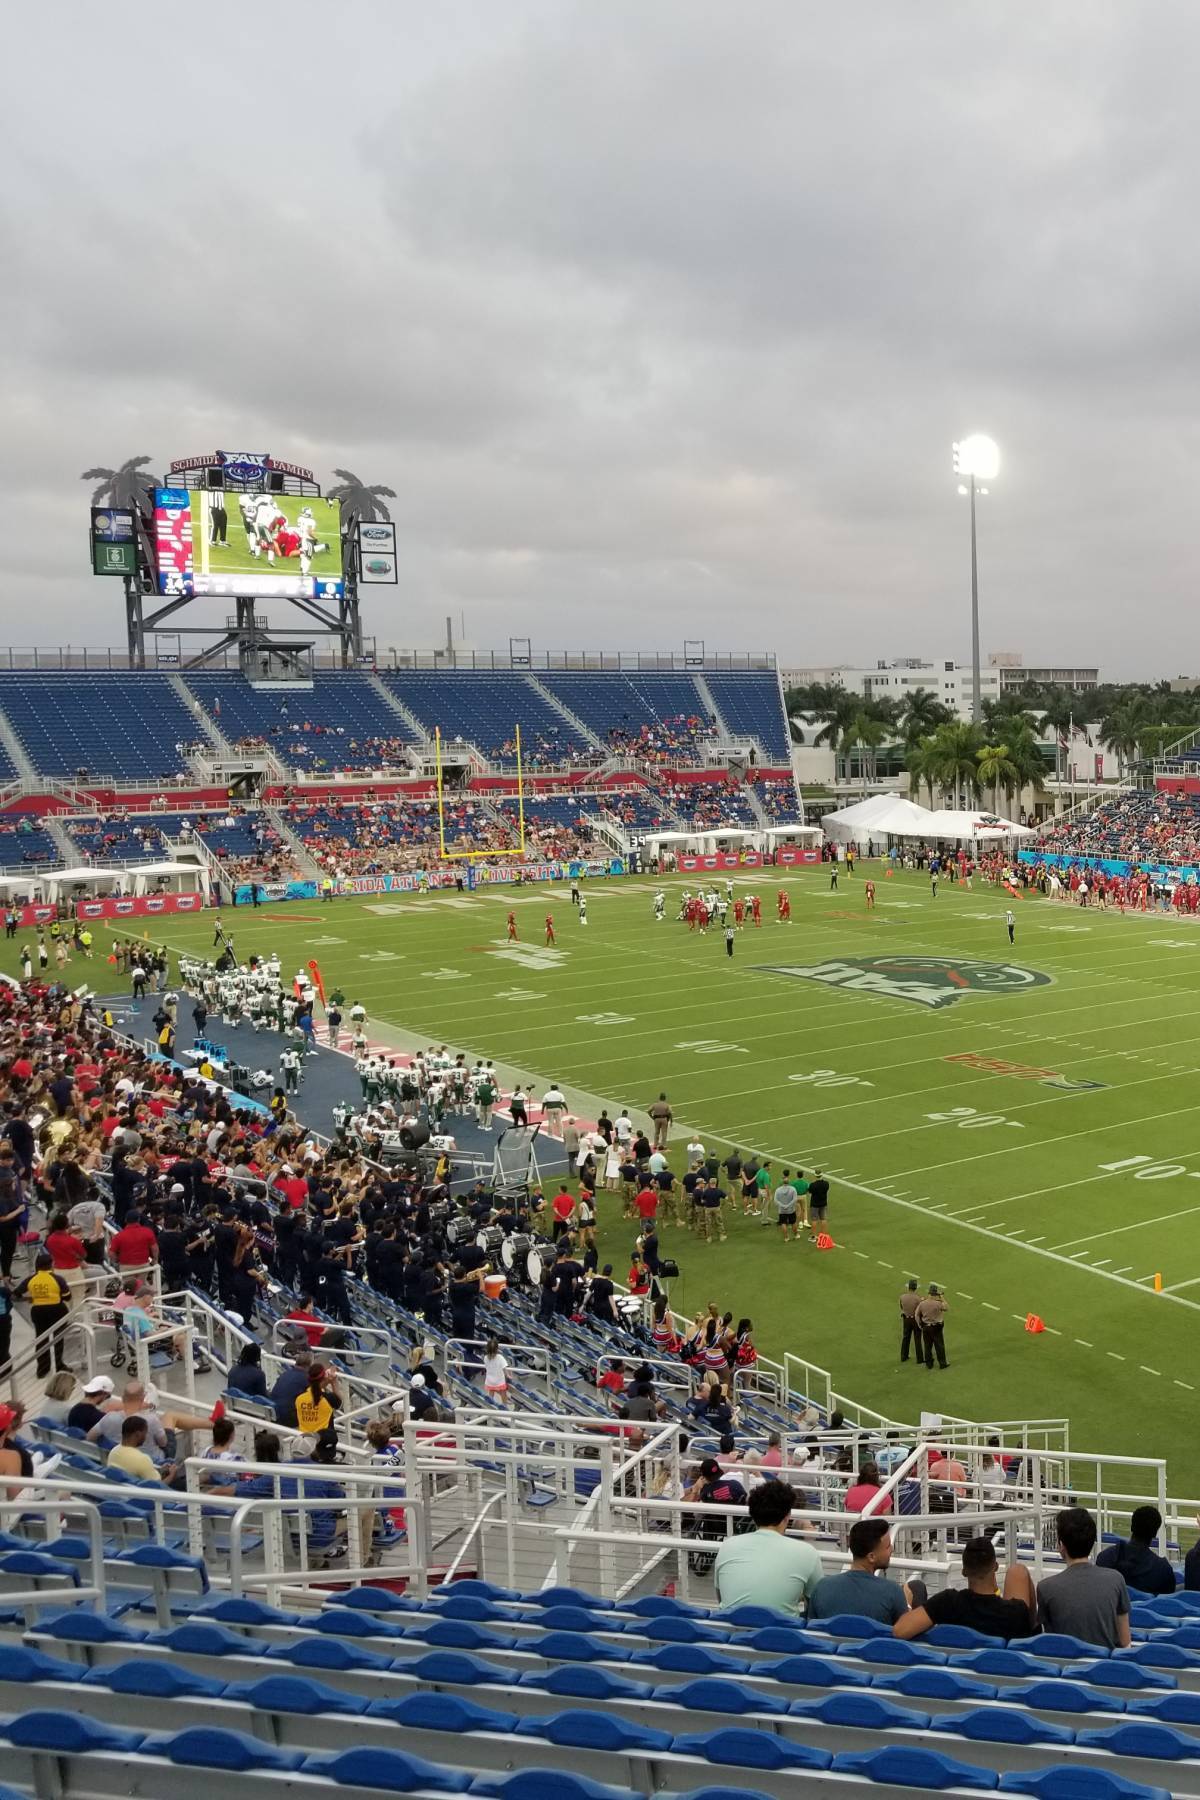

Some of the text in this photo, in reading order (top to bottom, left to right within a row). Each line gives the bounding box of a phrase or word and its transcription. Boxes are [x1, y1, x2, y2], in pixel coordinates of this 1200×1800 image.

[173, 455, 219, 471] SCHMIDT
[225, 454, 265, 466] FAU
[272, 461, 313, 477] FAMILY
[631, 836, 646, 847] 39
[922, 1107, 1006, 1128] 20
[1097, 1156, 1187, 1180] 10
[301, 1402, 319, 1411] CSC
